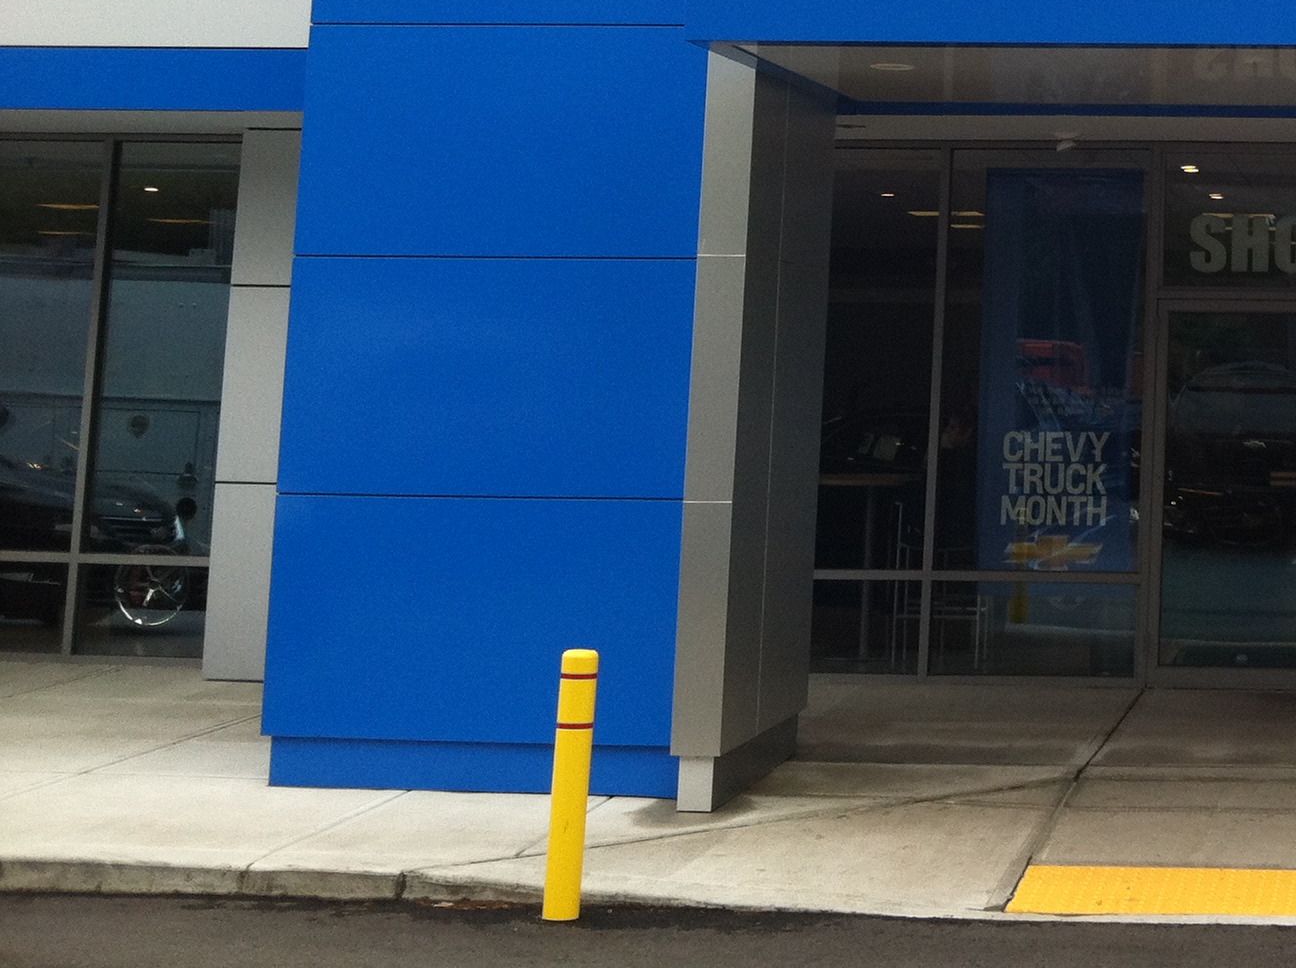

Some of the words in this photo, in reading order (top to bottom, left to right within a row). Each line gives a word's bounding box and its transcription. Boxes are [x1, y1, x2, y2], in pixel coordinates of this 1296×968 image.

[1002, 430, 1111, 463] CHEVY
[1001, 462, 1109, 495] TRUCK
[1000, 495, 1108, 527] MONTH
